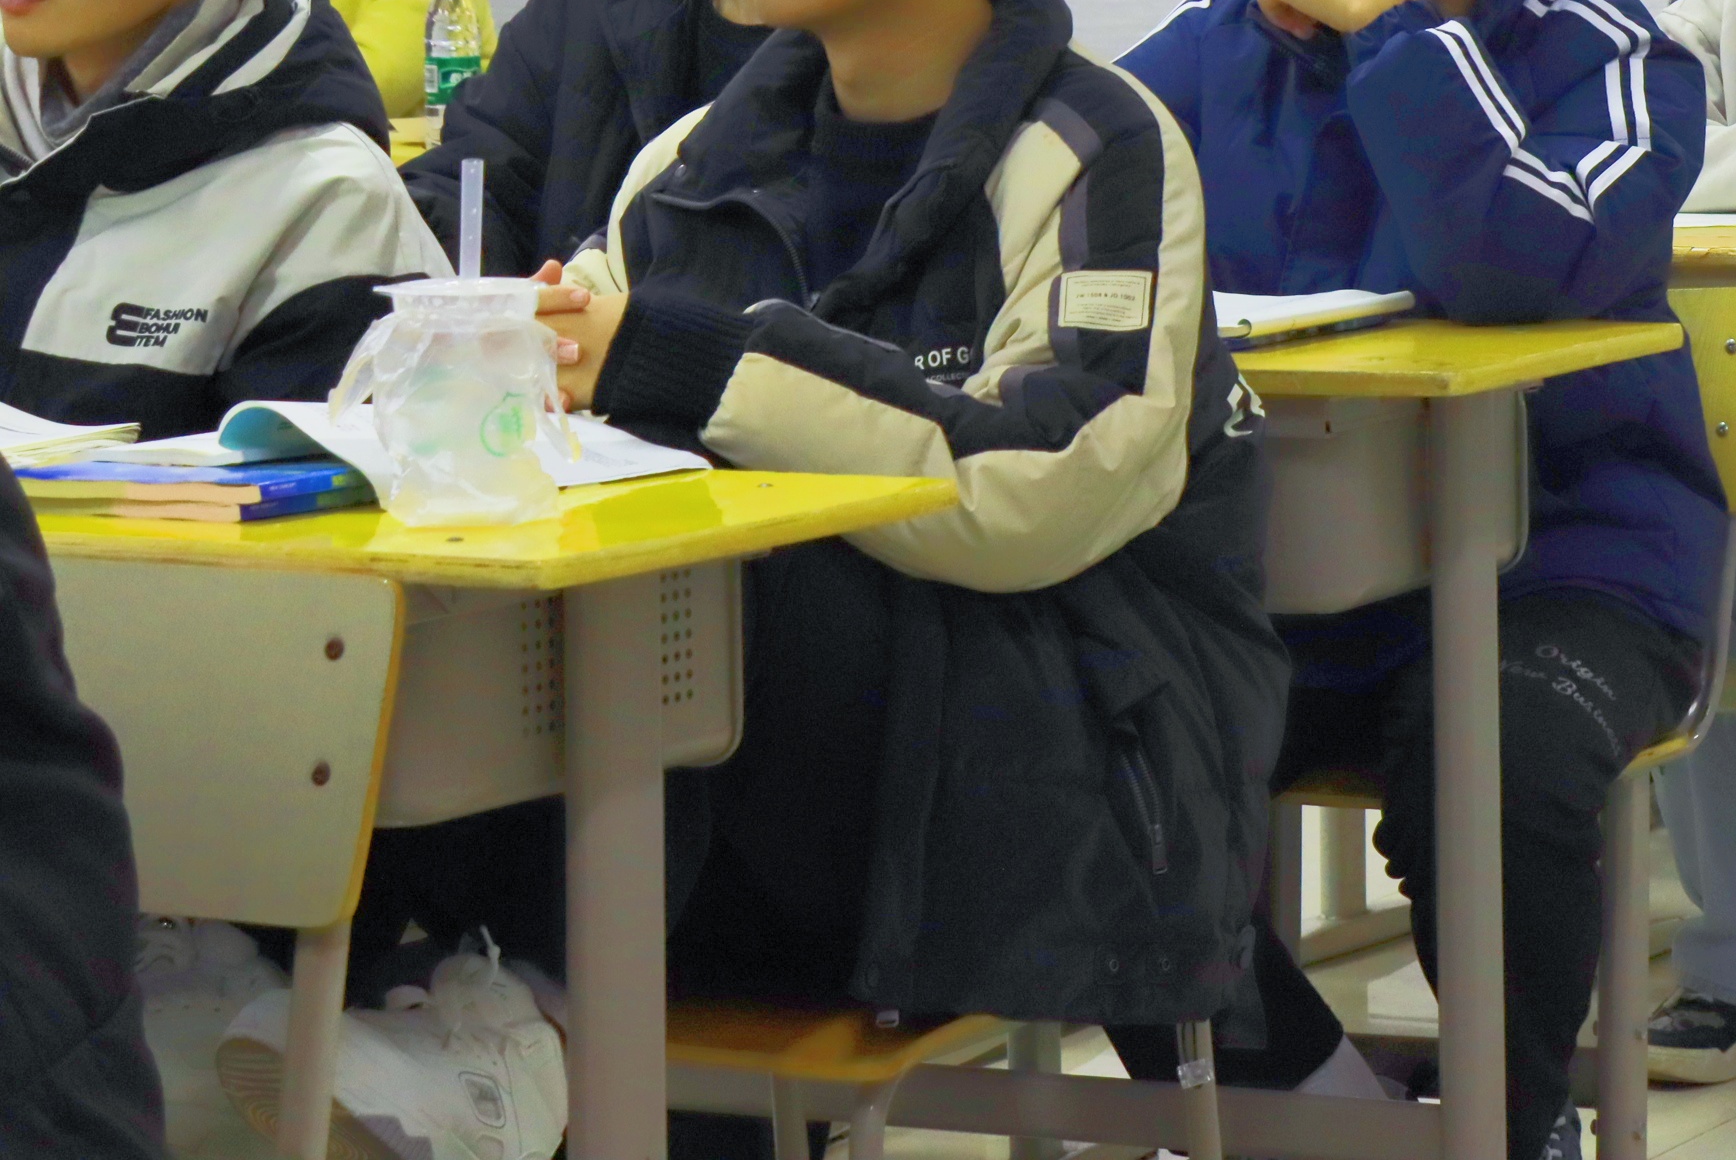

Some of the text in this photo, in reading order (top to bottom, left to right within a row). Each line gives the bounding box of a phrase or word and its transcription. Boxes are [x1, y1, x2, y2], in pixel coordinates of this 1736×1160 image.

[144, 307, 208, 323] FASHION
[138, 322, 181, 335] BOHUI
[928, 348, 952, 367] OF
[956, 346, 974, 364] G
